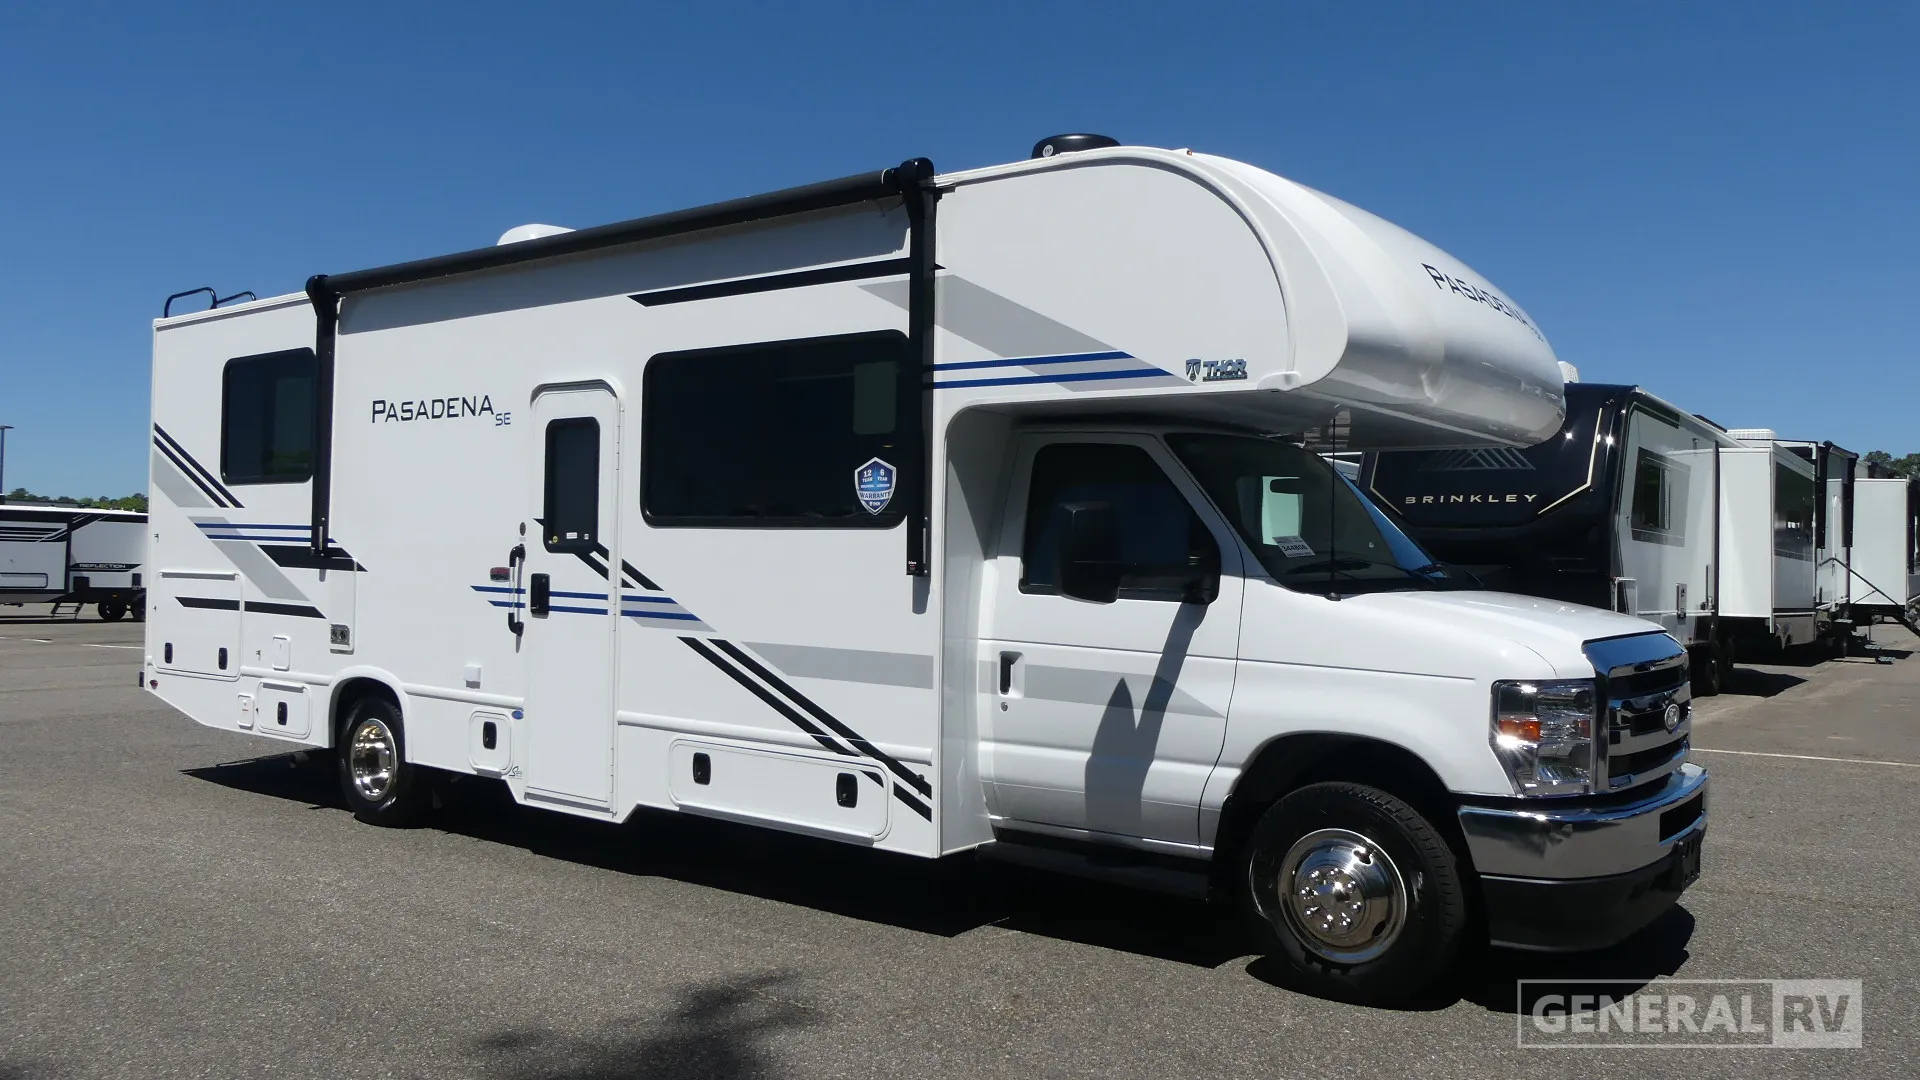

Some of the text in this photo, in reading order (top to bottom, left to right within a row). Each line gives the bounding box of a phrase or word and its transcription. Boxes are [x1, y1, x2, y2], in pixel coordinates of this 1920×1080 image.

[1203, 359, 1247, 376] THOR
[372, 395, 511, 426] PASADENA SE
[863, 469, 872, 478] 12
[1405, 494, 1537, 504] BRINKLEY
